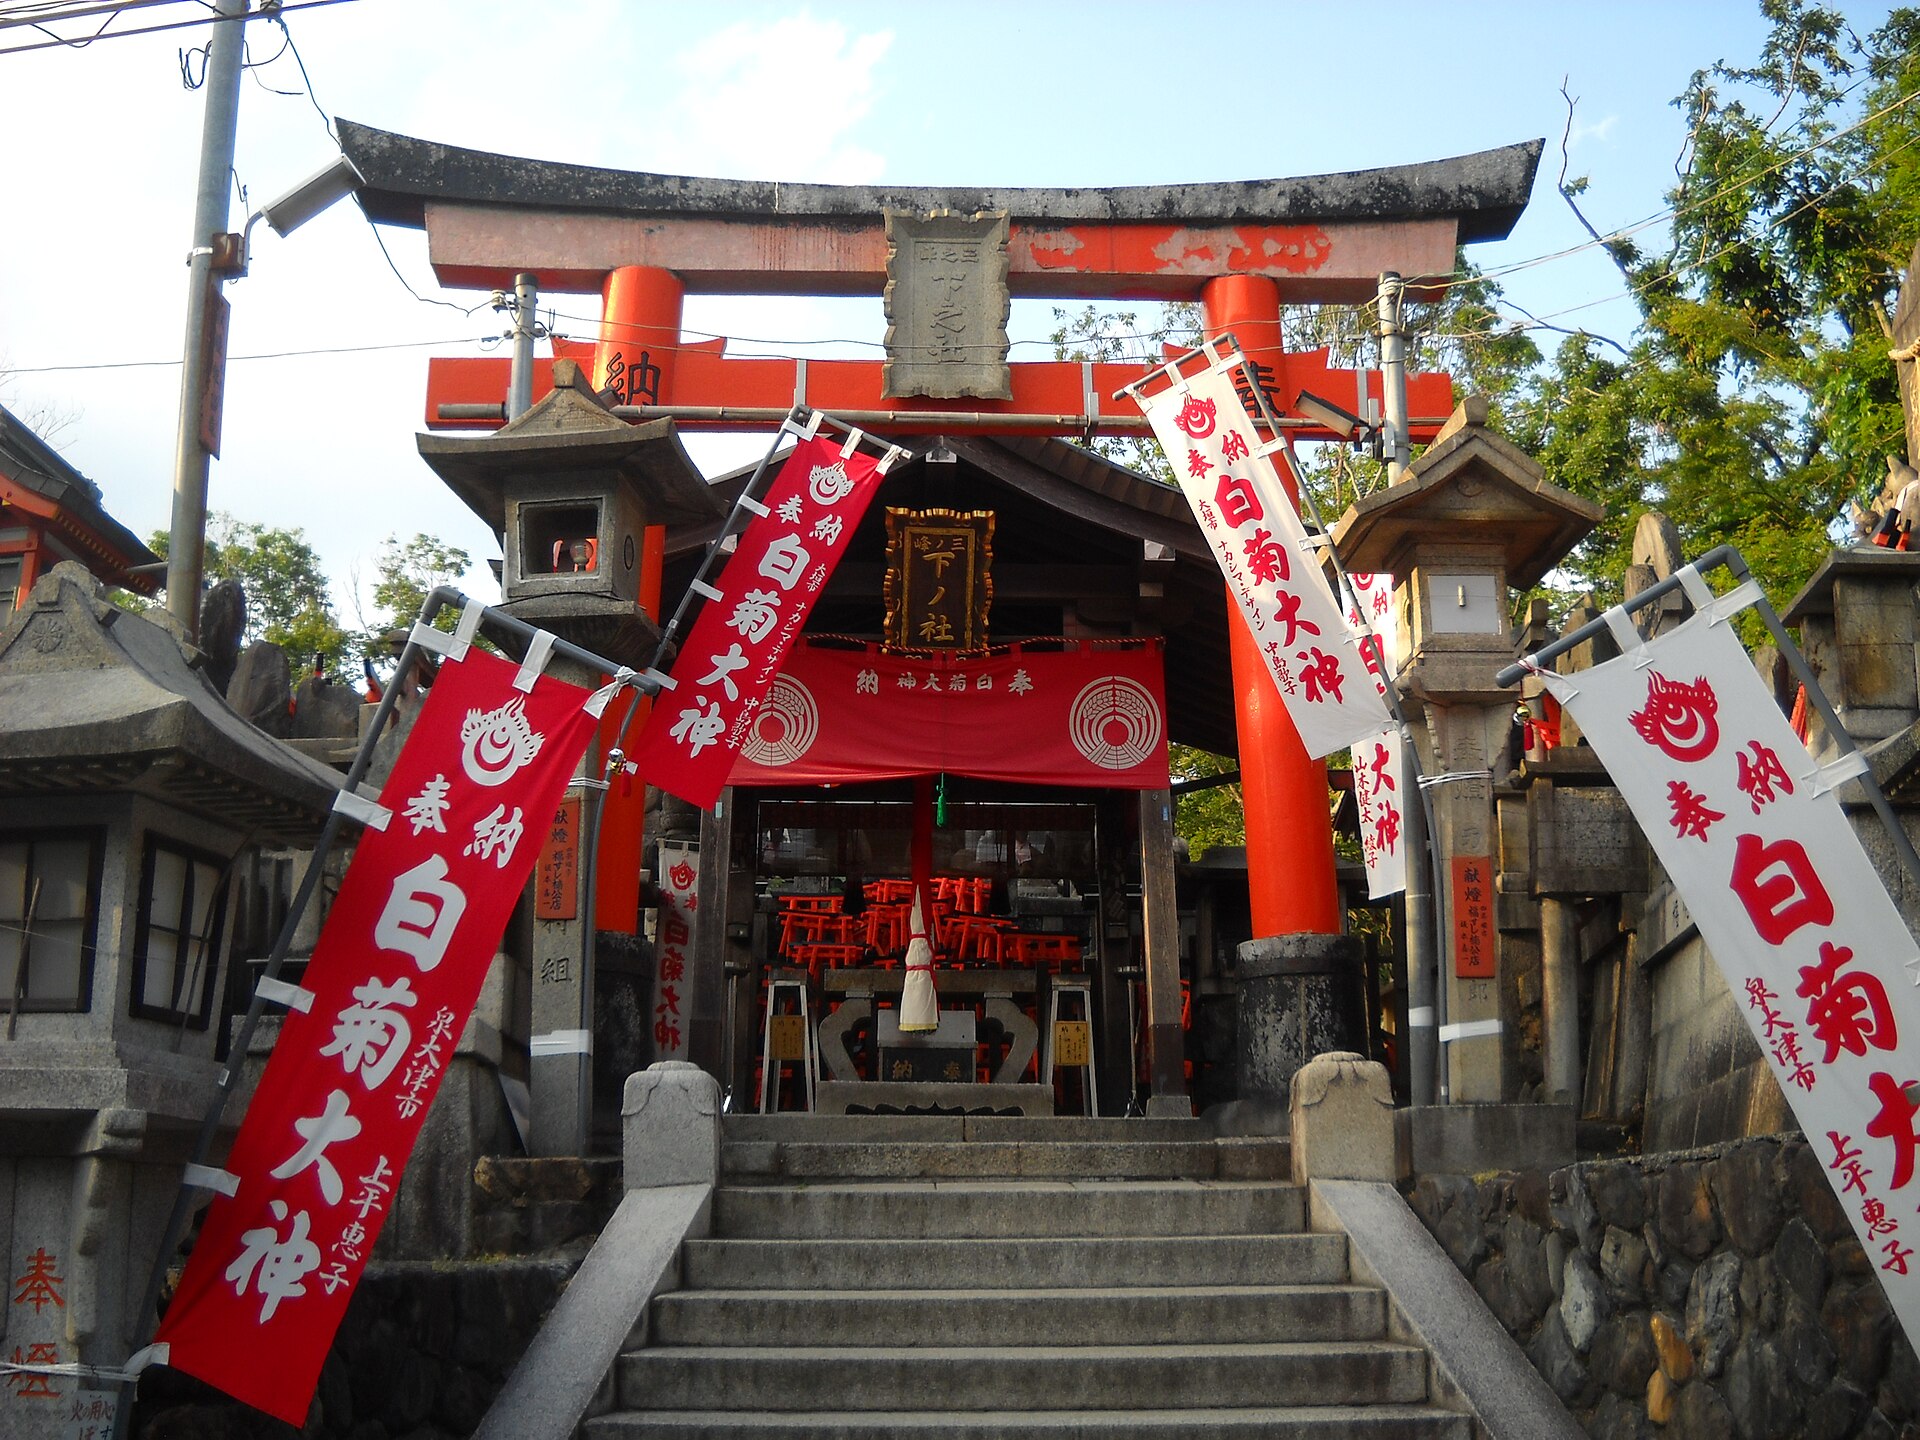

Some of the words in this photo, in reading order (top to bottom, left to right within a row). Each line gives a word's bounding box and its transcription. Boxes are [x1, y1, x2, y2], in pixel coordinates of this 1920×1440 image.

[605, 351, 661, 406] 納
[1235, 361, 1287, 418] 奉
[1186, 430, 1250, 480] 奉納
[775, 494, 843, 547] 奉納
[1198, 499, 1218, 530] 大垣市
[807, 563, 827, 593] 大垣市
[919, 551, 956, 642] 下ノ社
[1214, 474, 1345, 705] 白菊大神
[669, 532, 812, 759] 白菊大神
[856, 668, 879, 695] 納
[896, 673, 993, 691] 白菊大神
[1008, 668, 1034, 696] 奉
[401, 774, 523, 868] 奉納
[1667, 740, 1795, 843] 奉納
[1463, 867, 1482, 902] 献燈
[1729, 832, 1920, 1213] 白菊大
[1744, 976, 1816, 1093] 泉大津市
[225, 853, 467, 1325] 白菊大神
[395, 1005, 455, 1120] 泉大津市
[7, 1247, 65, 1398] 奉燈
